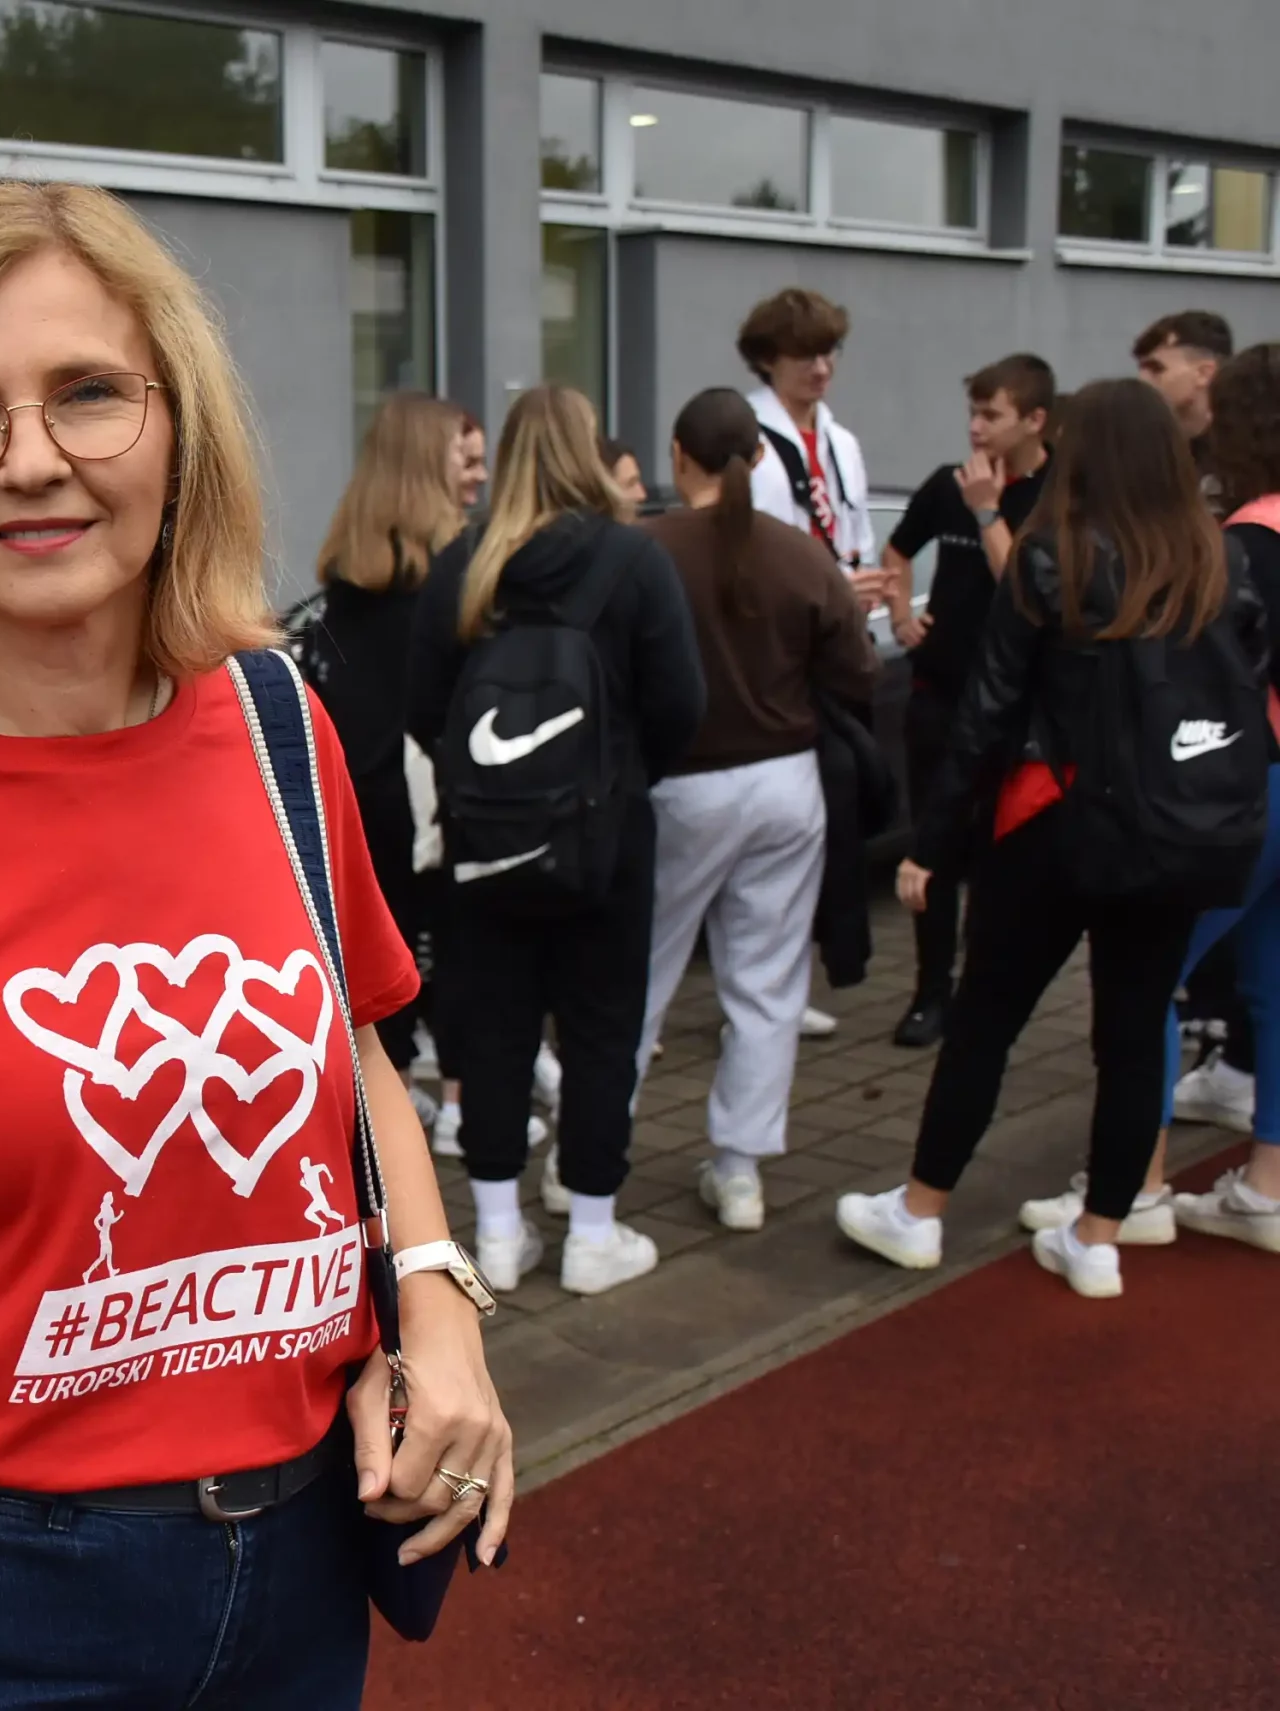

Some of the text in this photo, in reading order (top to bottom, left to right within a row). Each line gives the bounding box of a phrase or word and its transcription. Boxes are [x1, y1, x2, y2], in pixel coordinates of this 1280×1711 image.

[1178, 718, 1227, 744] NIKE
[44, 1239, 357, 1359] #BEACTIVE
[8, 1312, 351, 1404] EUROPSKI TJEDAN SPORTA
